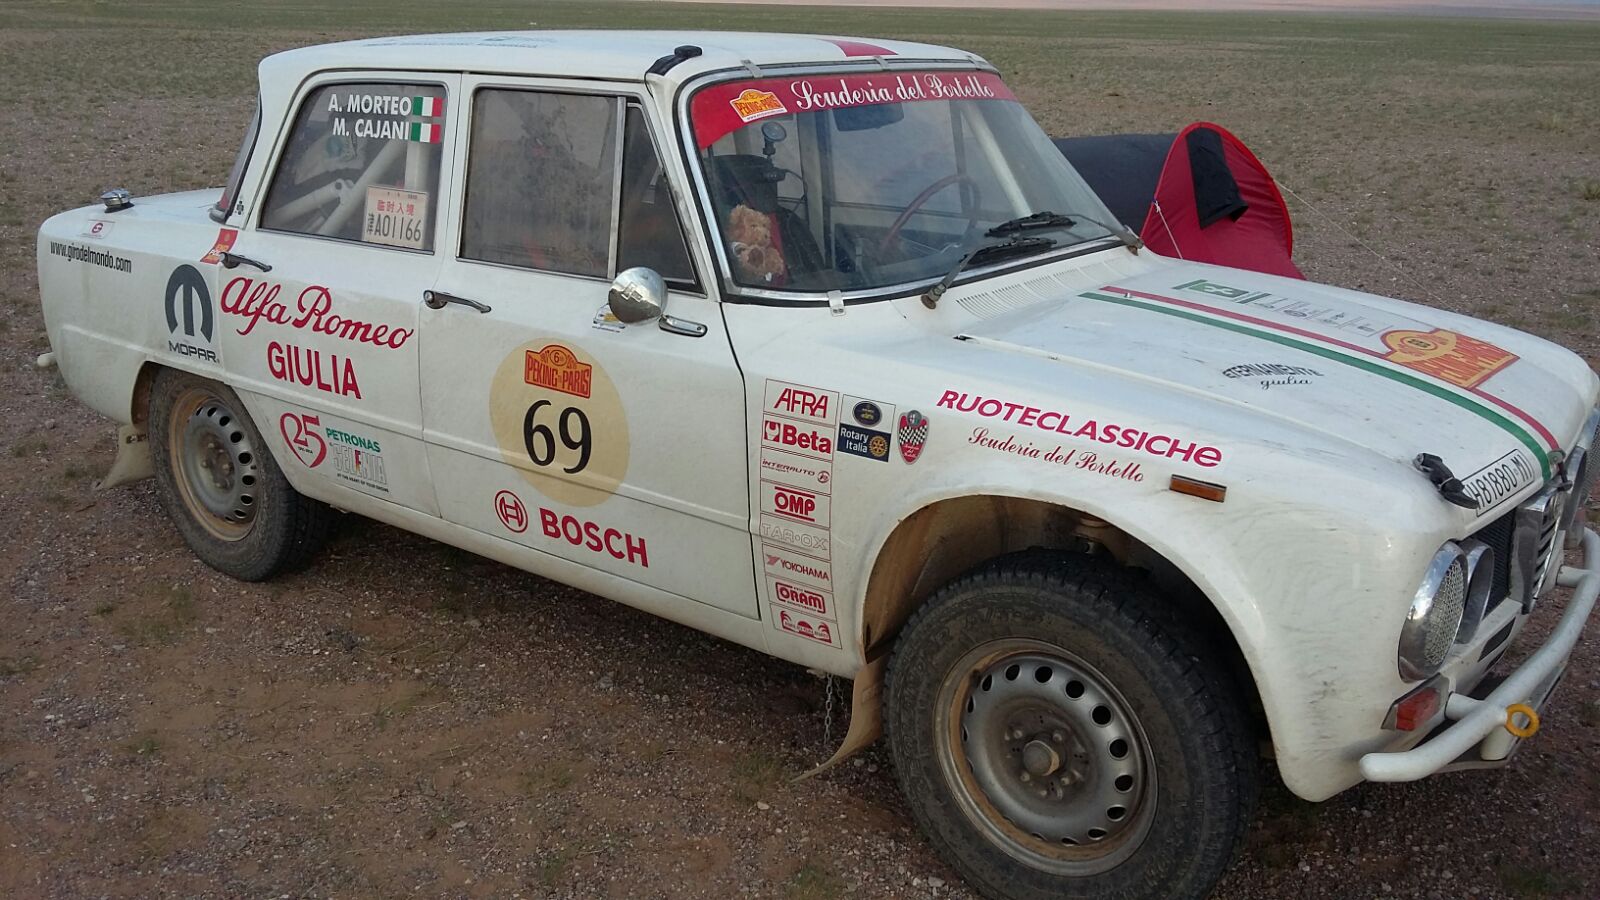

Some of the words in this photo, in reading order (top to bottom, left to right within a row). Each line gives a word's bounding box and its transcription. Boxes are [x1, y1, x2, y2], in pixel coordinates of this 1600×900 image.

[328, 93, 342, 113] A.
[347, 94, 412, 116] MORTEO
[791, 80, 893, 110] Scuderia
[896, 75, 926, 100] del
[924, 73, 994, 98] Portello
[332, 118, 349, 137] M.
[355, 120, 410, 140] CAJANI
[50, 241, 132, 273] www.girodelmondo.com
[220, 276, 292, 336] Alfa
[292, 285, 415, 349] Romeo
[168, 340, 217, 363] MOPAR
[267, 341, 362, 400] GIULIA
[527, 355, 558, 387] PEKING
[563, 369, 590, 395] PARIS
[1260, 376, 1313, 390] giulia
[773, 387, 829, 419] AFRA
[326, 427, 381, 453] PETRONAS
[523, 399, 592, 474] 69
[782, 425, 832, 454] Beta
[840, 427, 869, 444] Rotary
[846, 440, 868, 453] Italia
[968, 427, 1041, 459] Scuderia
[1043, 445, 1076, 466] del
[1075, 451, 1145, 483] Portello
[775, 491, 816, 516] OMP
[539, 507, 649, 568] BOSCH
[780, 559, 830, 581] YOKOHAMA
[779, 586, 822, 610] ORAM
